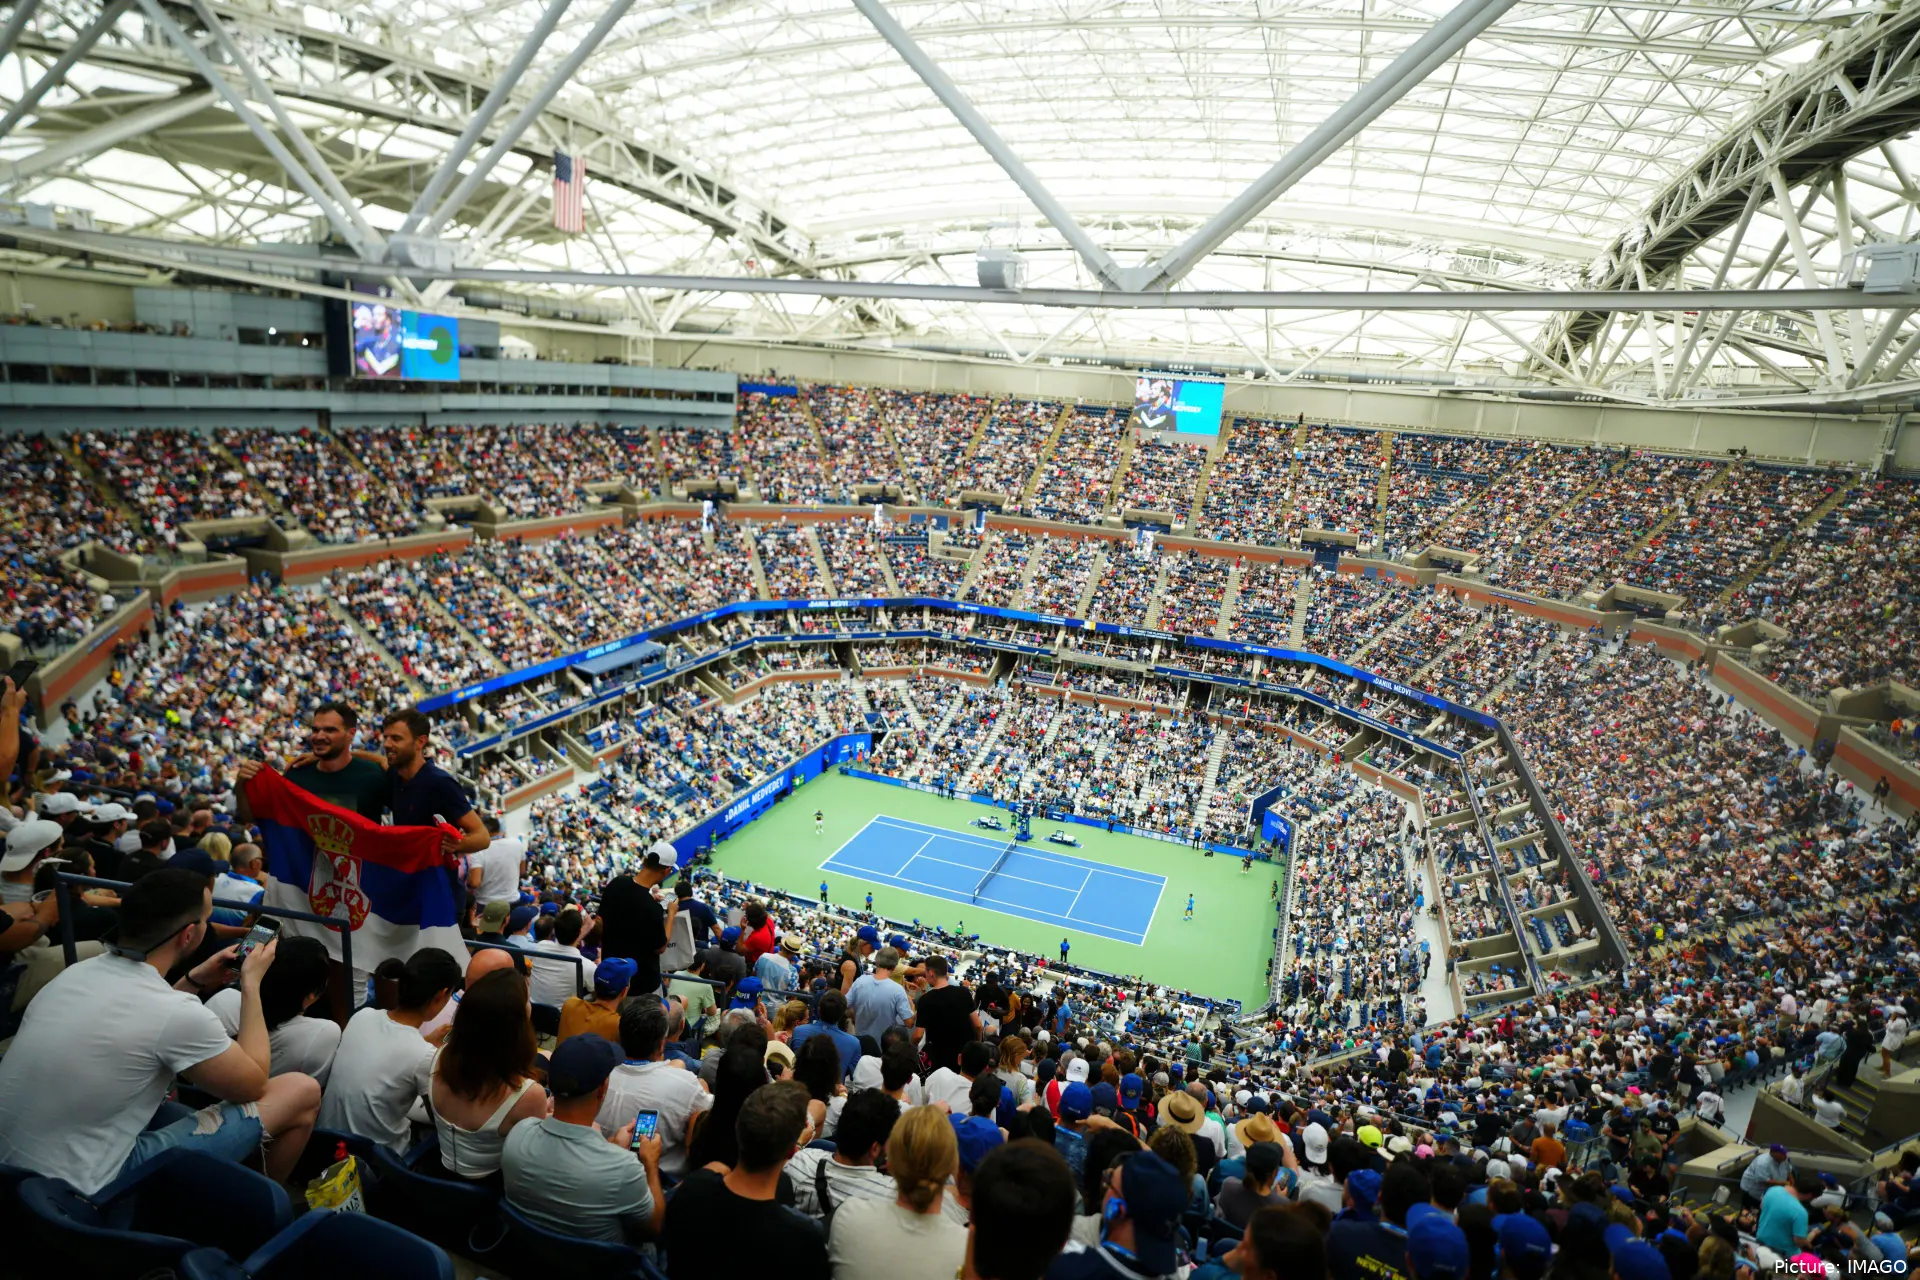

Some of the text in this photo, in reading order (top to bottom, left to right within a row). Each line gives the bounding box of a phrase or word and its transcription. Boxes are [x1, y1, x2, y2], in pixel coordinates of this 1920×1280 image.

[1375, 677, 1393, 690] DANIIL
[728, 797, 750, 820] DANIIL
[751, 775, 785, 805] MEDVEDEV
